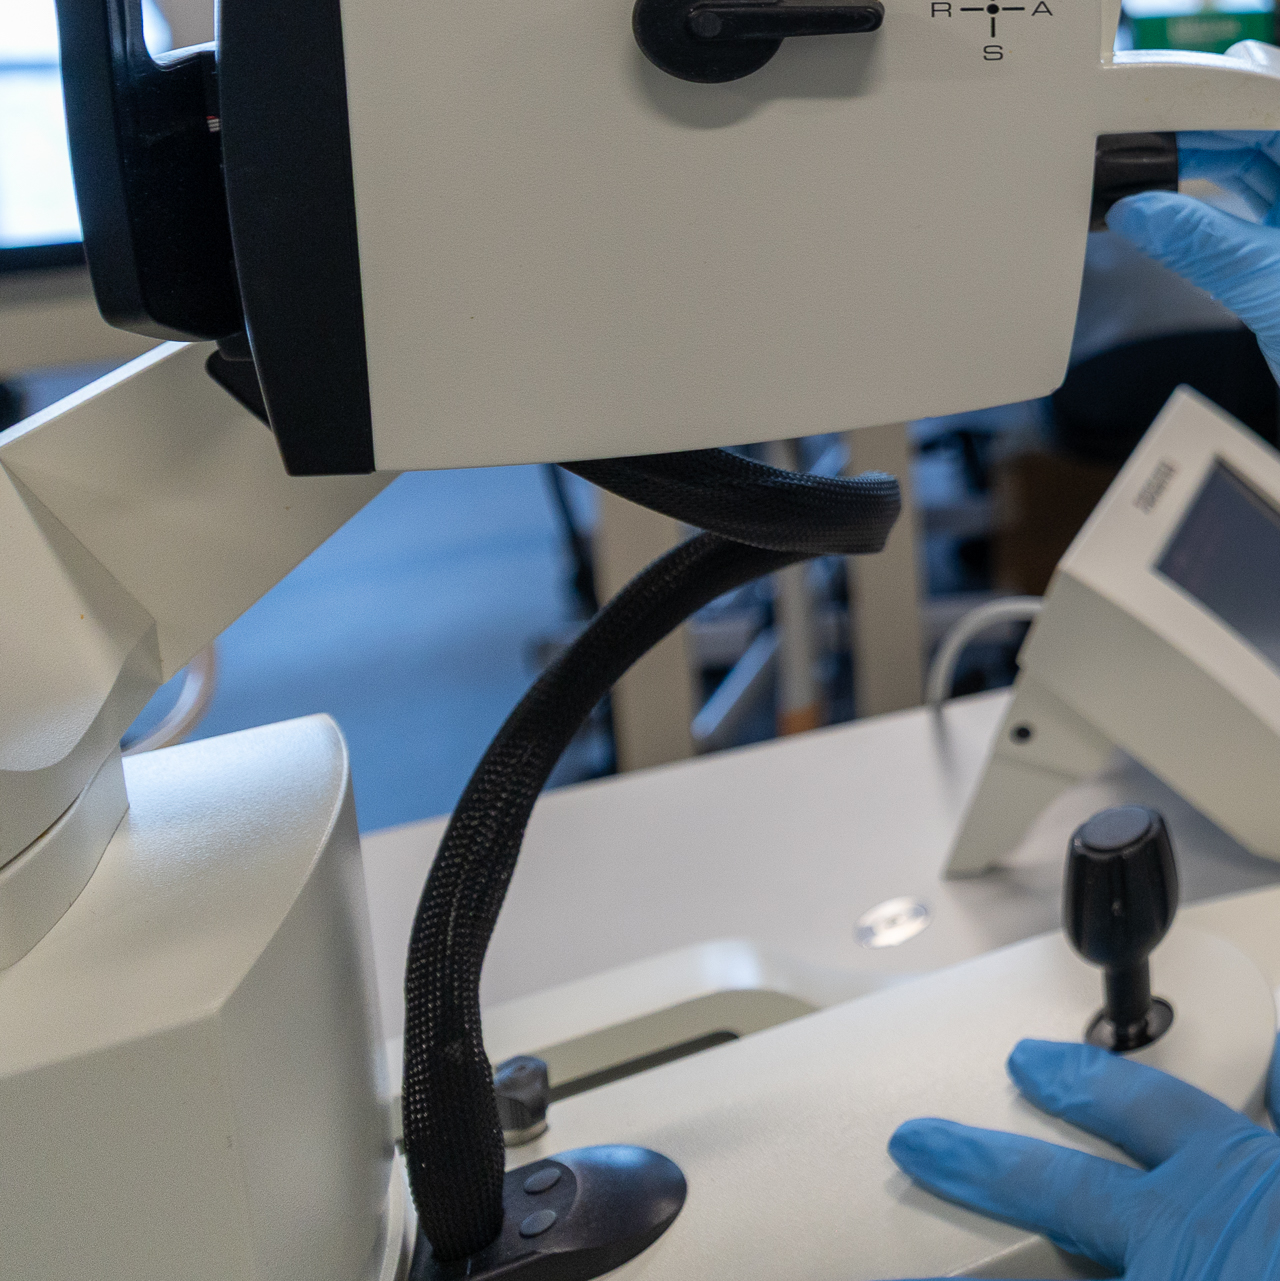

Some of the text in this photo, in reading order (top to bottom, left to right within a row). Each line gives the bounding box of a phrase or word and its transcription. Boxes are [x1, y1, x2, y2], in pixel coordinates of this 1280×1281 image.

[930, 1, 952, 18] R
[1031, 0, 1054, 17] A
[982, 44, 1004, 62] S
